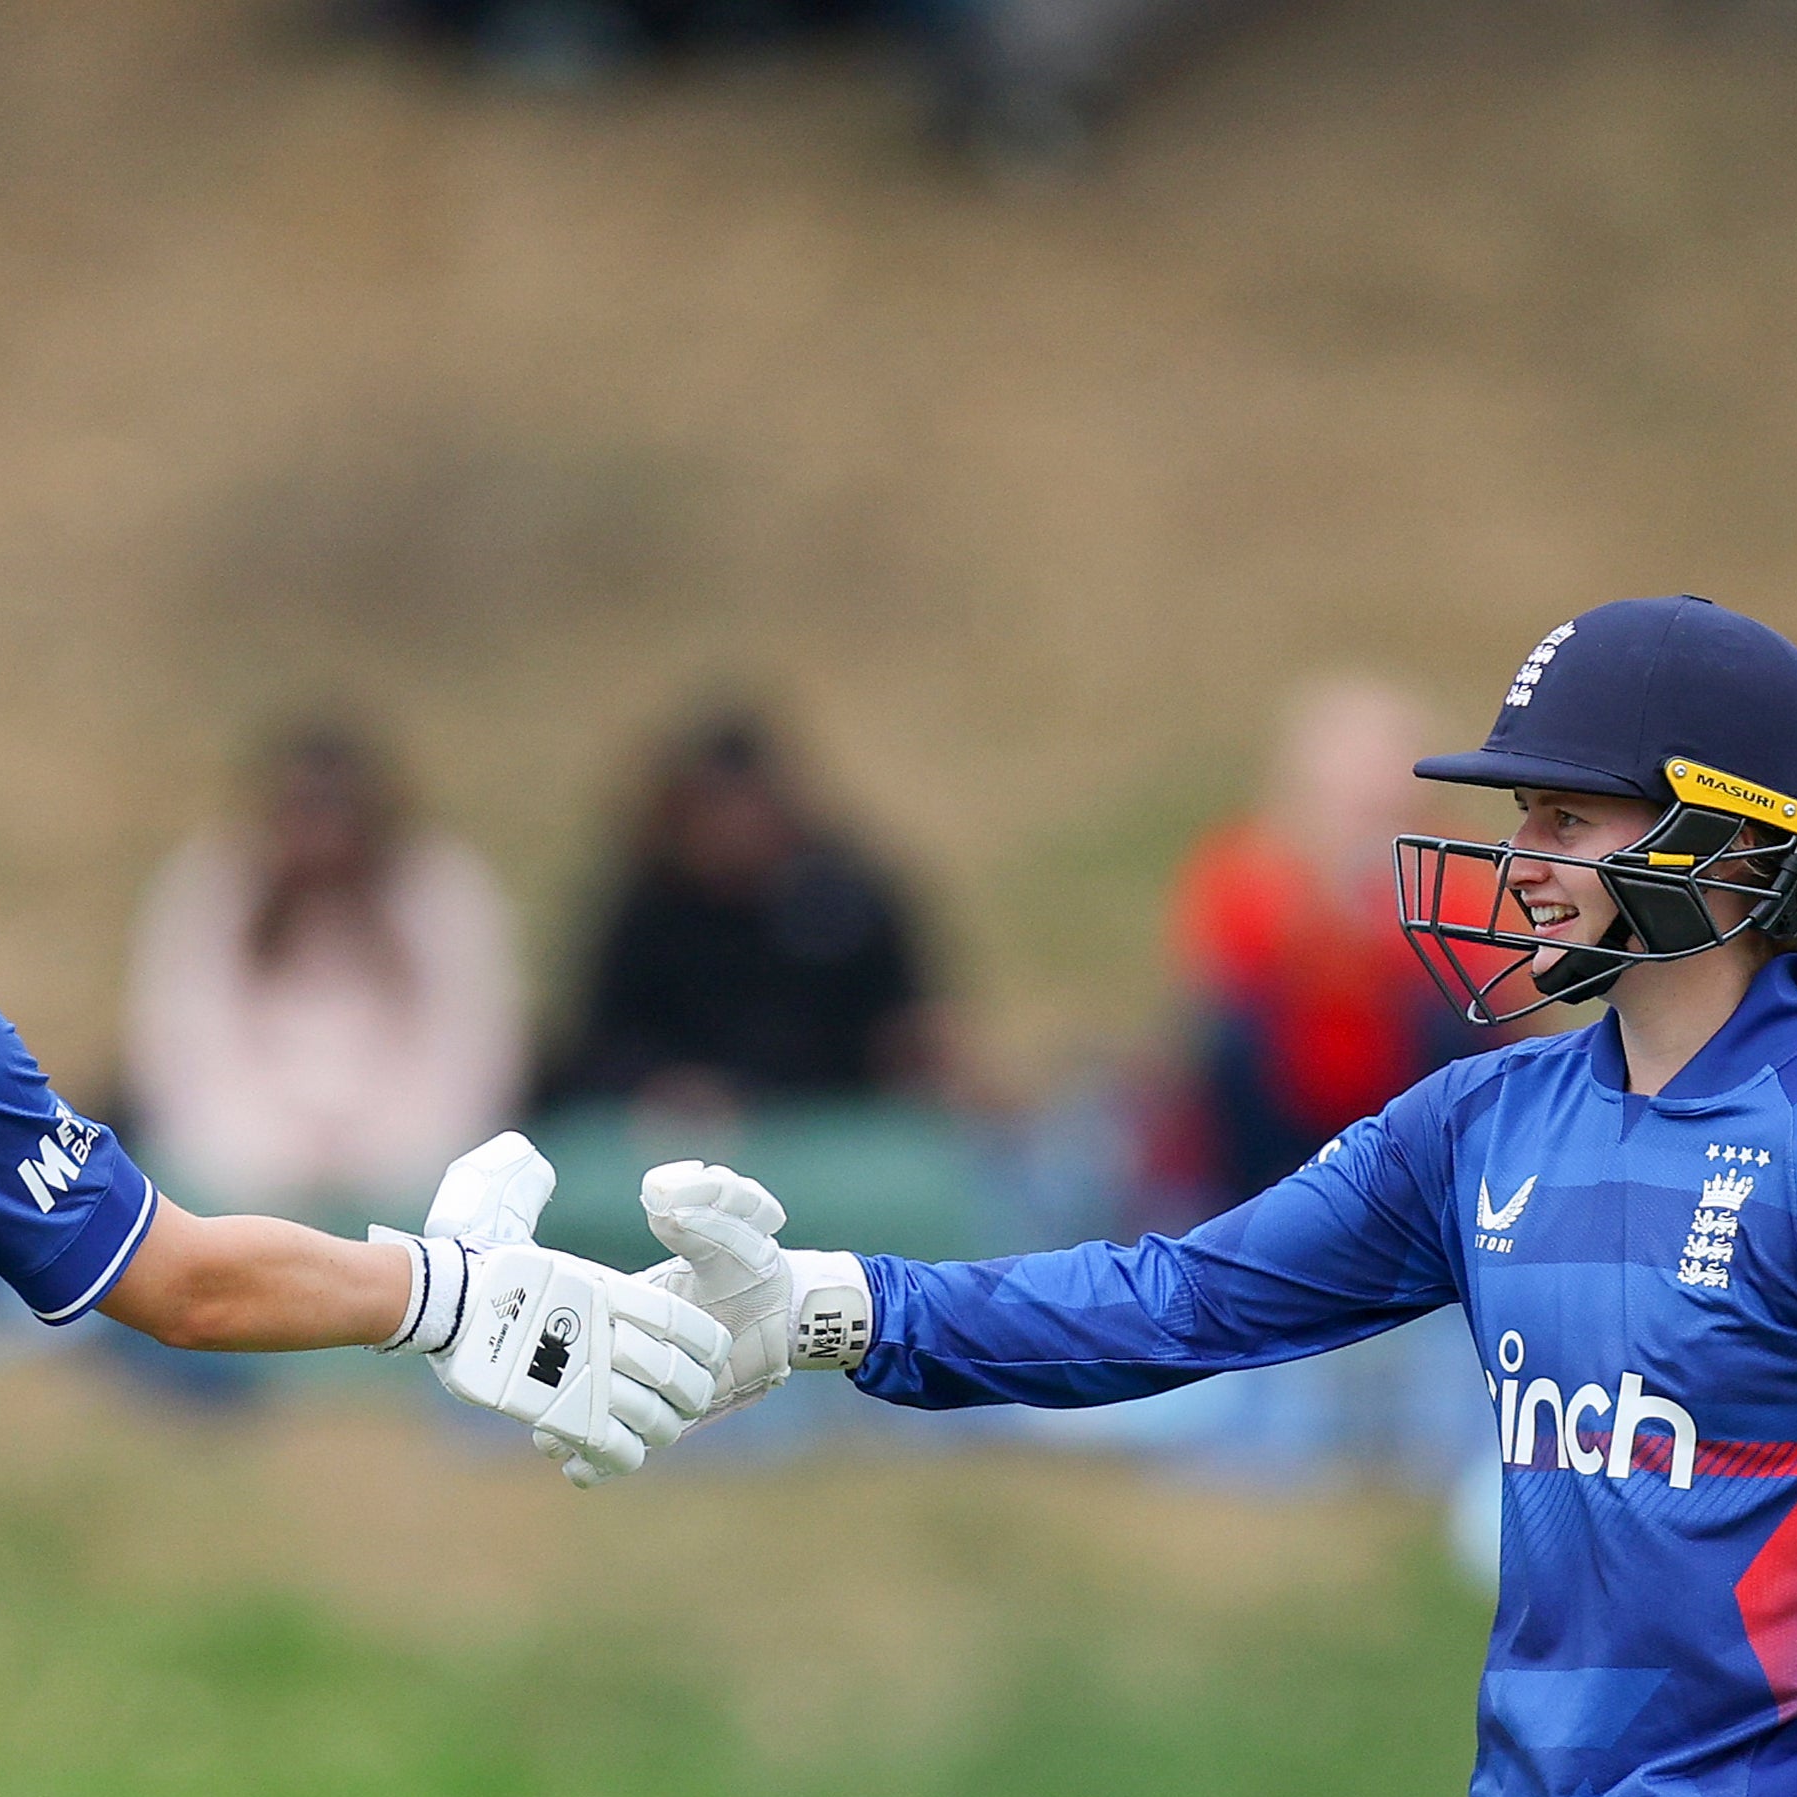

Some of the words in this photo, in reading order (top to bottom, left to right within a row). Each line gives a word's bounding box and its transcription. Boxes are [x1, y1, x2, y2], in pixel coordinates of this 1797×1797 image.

[1696, 773, 1776, 810] MASURI
[1475, 1233, 1514, 1254] TORE
[1485, 1329, 1697, 1490] inch
